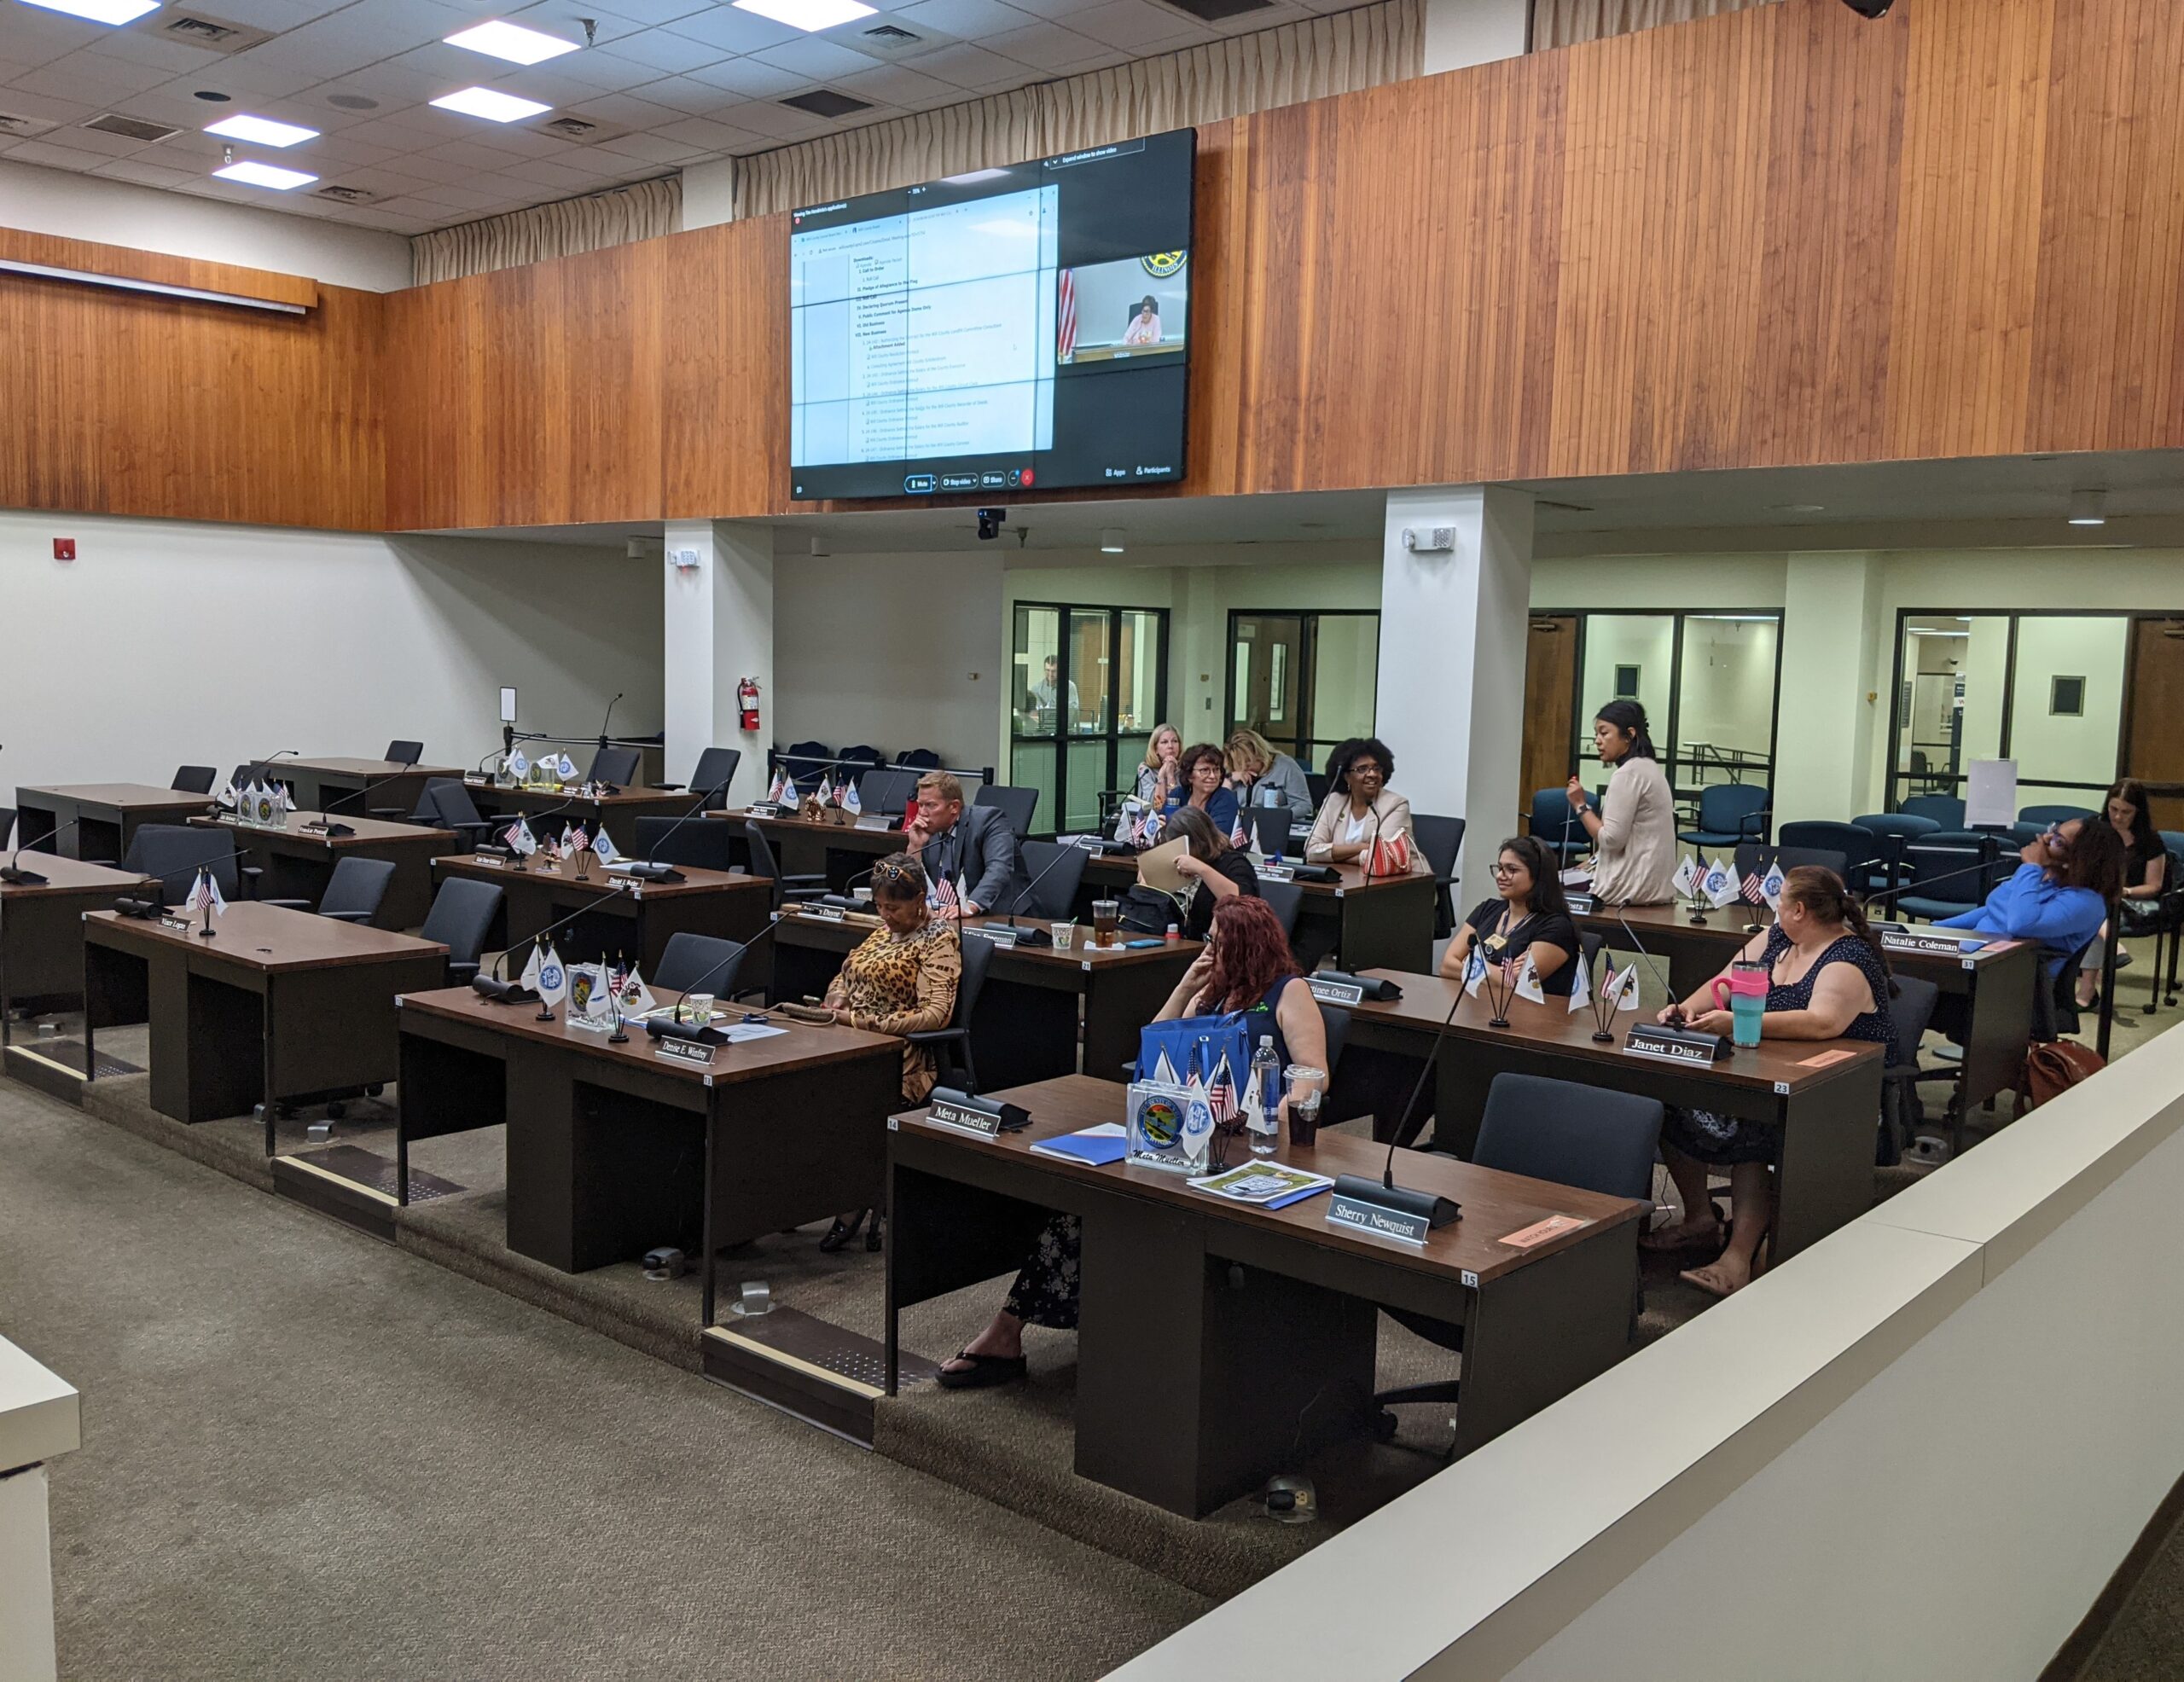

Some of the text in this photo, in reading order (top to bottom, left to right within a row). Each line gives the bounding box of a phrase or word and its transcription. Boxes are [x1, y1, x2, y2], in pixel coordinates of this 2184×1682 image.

[823, 908, 841, 918] Duyne
[1884, 936, 1957, 952] Natalie Coleman
[1310, 985, 1351, 1000] tinee Ortiz
[662, 1041, 681, 1053] Denise
[688, 1046, 708, 1061] Winfrey
[1631, 1038, 1703, 1058] Janet Diaz
[1776, 1084, 1787, 1093] 23
[889, 1120, 897, 1128] 14
[935, 1106, 991, 1130] Meta Mueller
[1133, 1149, 1184, 1166] Meta Mueller
[1334, 1204, 1414, 1236] Sherry Newquist
[1464, 1273, 1476, 1285] 15
